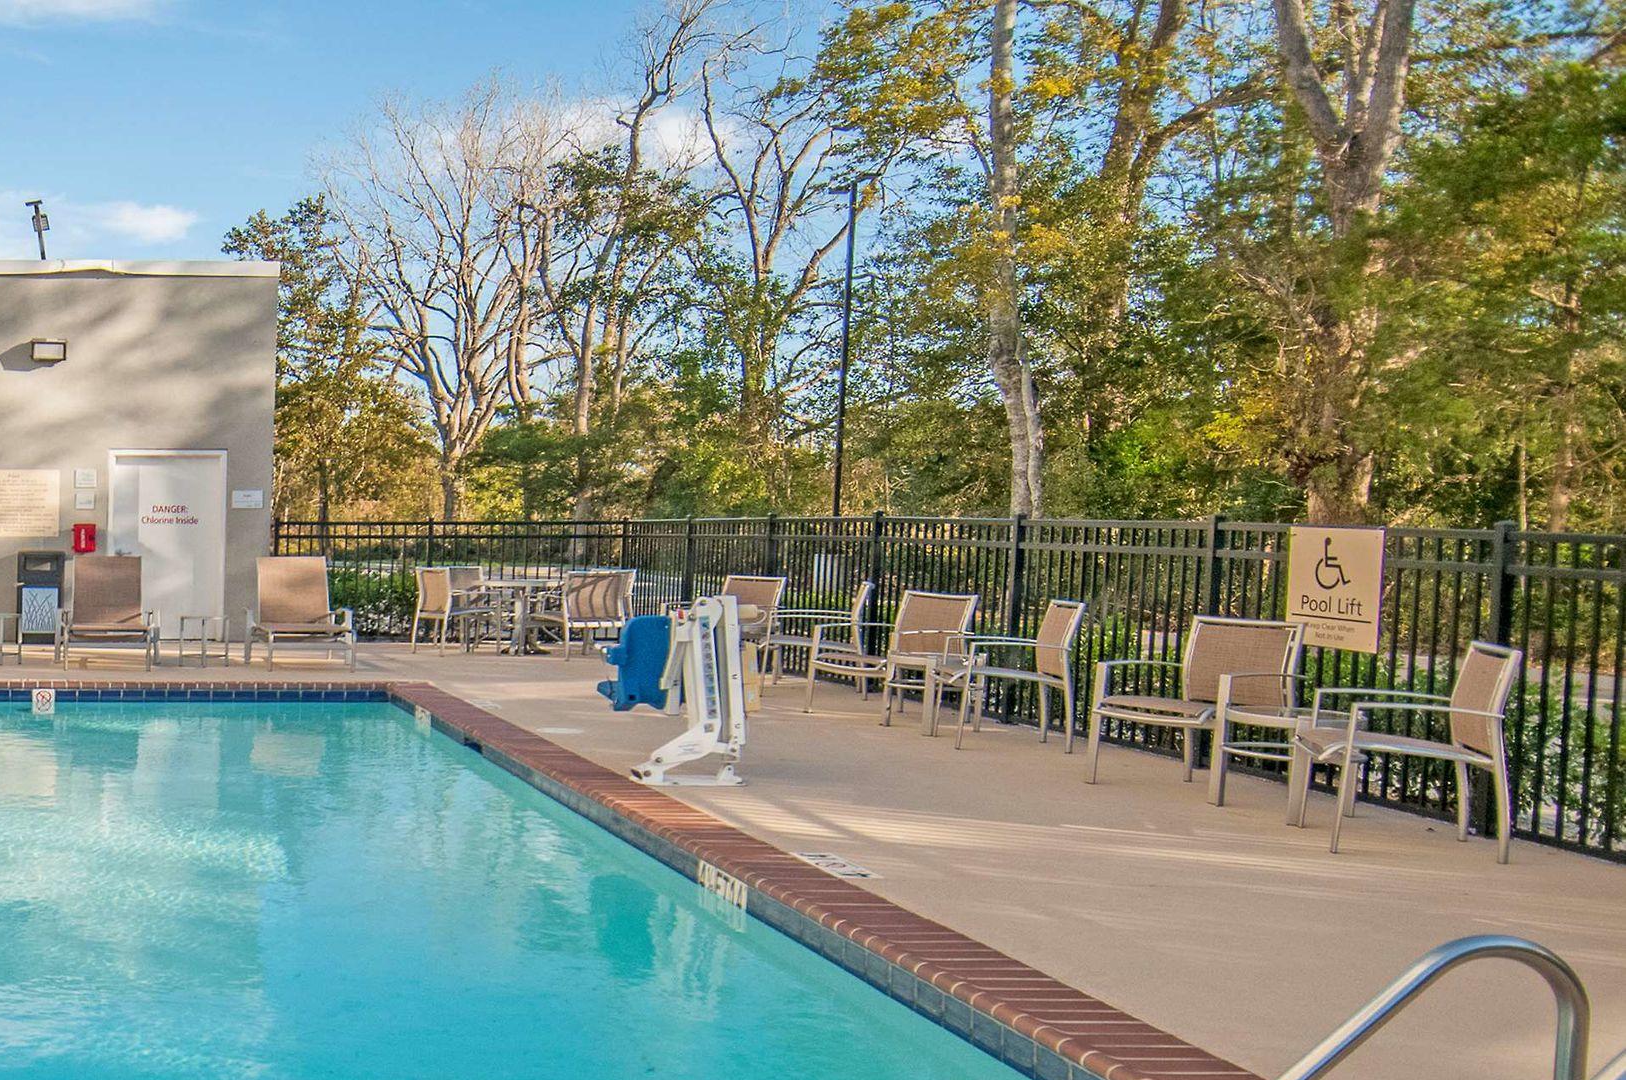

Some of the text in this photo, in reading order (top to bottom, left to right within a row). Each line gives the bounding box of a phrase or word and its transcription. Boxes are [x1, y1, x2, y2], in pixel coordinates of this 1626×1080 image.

[141, 515, 199, 525] Chlorine Inside
[1301, 594, 1362, 616] Pool Lift
